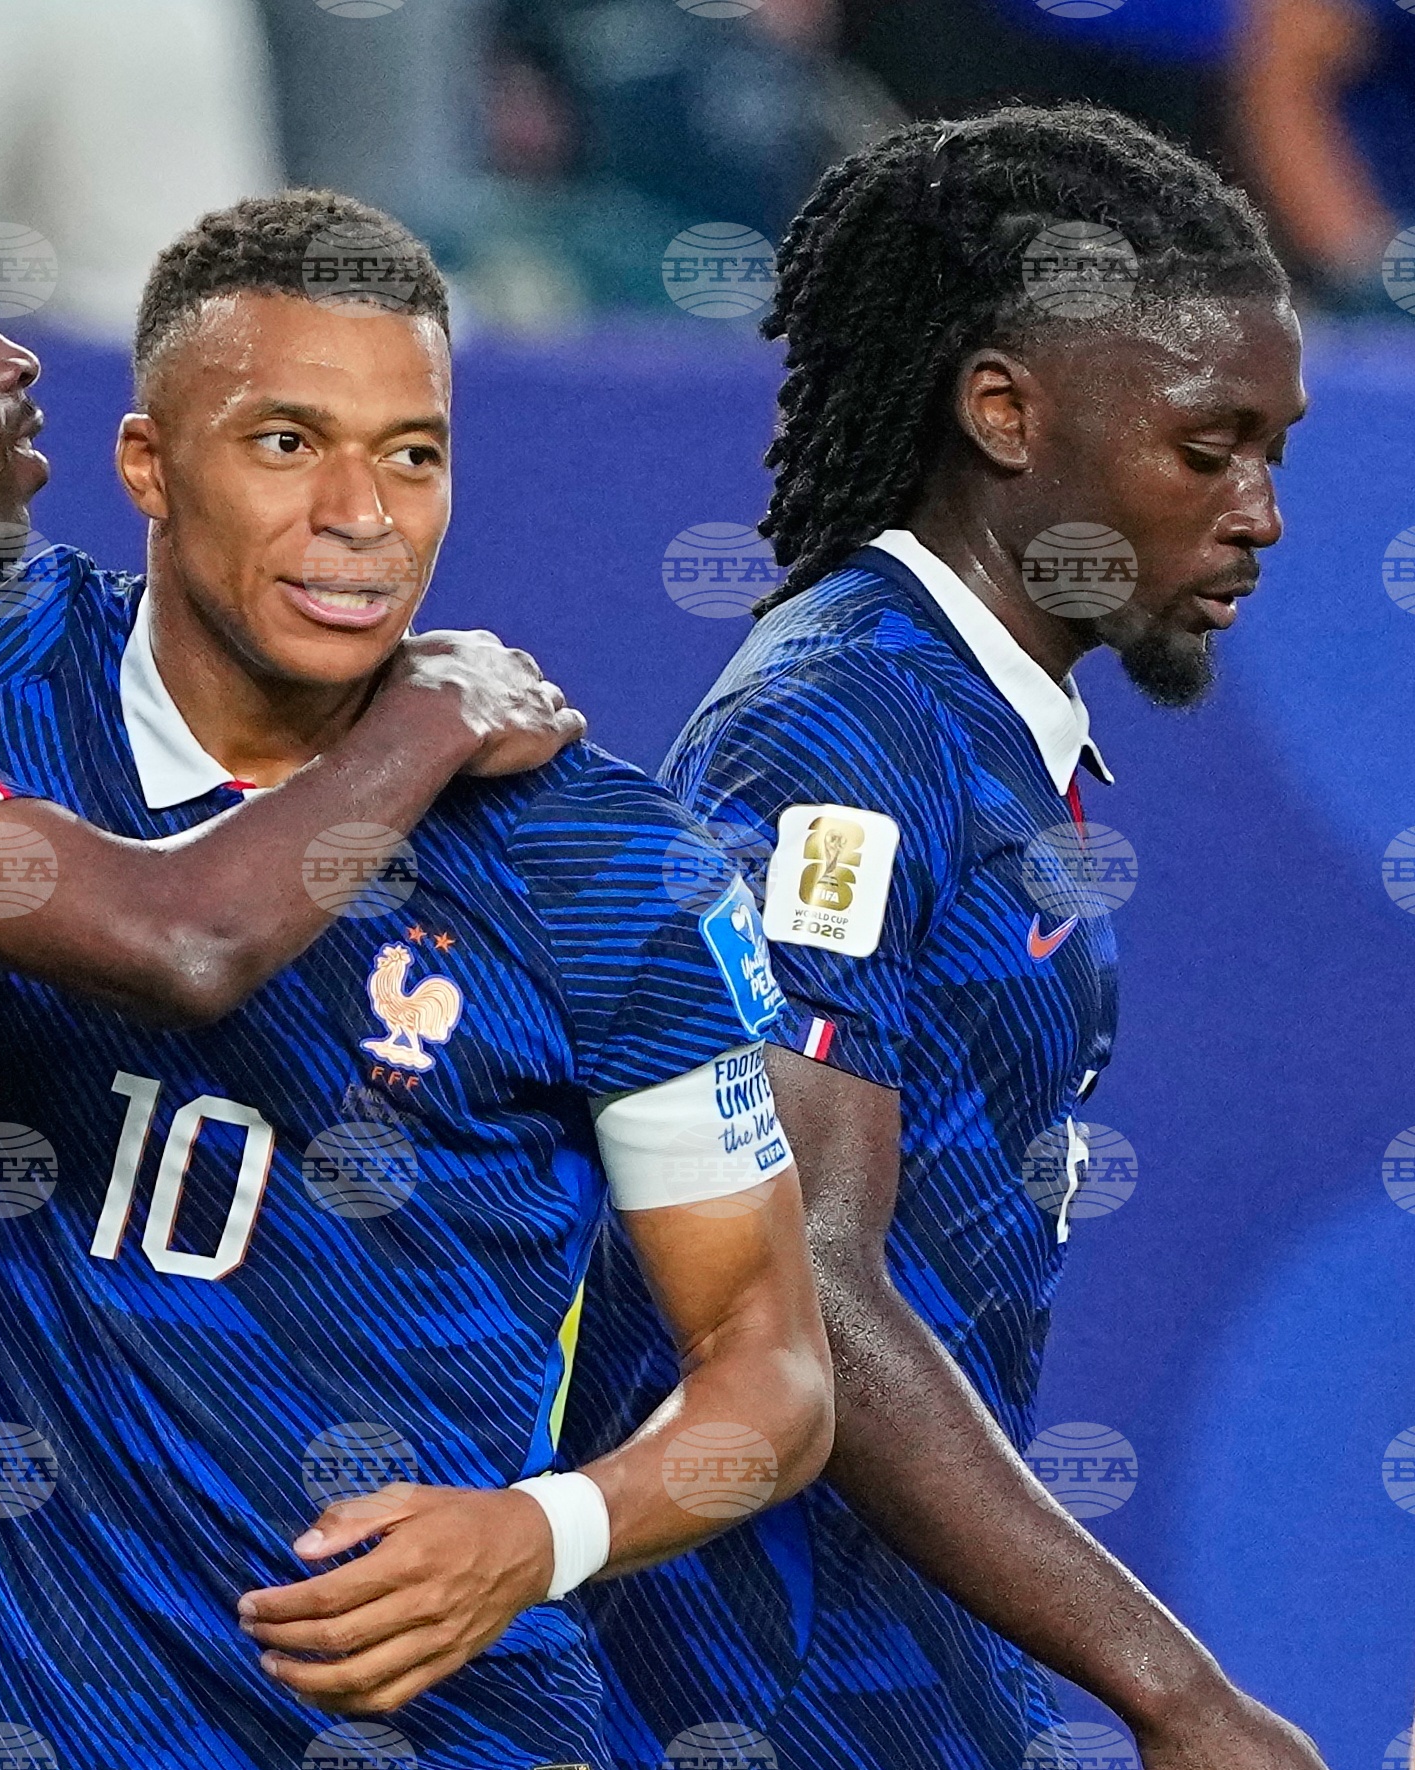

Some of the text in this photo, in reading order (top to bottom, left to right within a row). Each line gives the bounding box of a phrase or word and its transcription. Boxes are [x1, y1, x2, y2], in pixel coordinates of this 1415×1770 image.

[794, 909, 849, 925] WORLD CUP
[792, 919, 847, 940] 2026
[371, 1065, 420, 1090] FFF
[718, 1108, 778, 1154] the Wo
[757, 1144, 785, 1168] FIFA
[89, 1069, 275, 1281] 10
